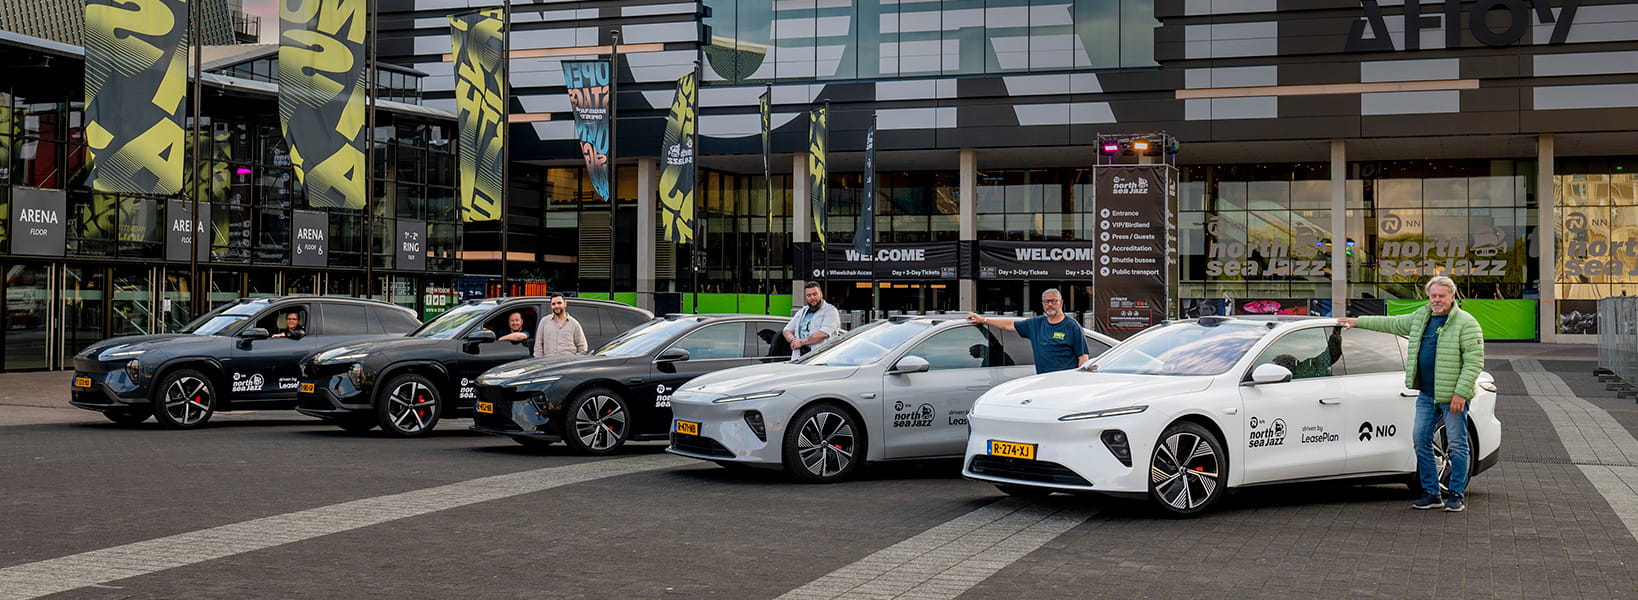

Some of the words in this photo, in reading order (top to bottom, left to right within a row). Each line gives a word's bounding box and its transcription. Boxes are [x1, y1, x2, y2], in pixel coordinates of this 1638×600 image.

[1345, 0, 1578, 51] AHOY
[20, 208, 58, 224] ARENA
[30, 228, 47, 236] FLOOR
[173, 219, 204, 233] AREA
[297, 228, 323, 240] ARENA
[403, 242, 419, 252] RING
[1209, 237, 1289, 258] north
[1382, 236, 1468, 258] north
[1567, 237, 1638, 257] nort
[1015, 248, 1094, 261] WELCOM
[1206, 260, 1259, 276] sea
[1380, 260, 1435, 276] sea
[1564, 259, 1623, 276] sea
[894, 411, 920, 420] north
[893, 420, 911, 428] sea
[1375, 424, 1397, 438] NIO
[1250, 428, 1274, 440] north
[1301, 432, 1339, 443] LeasePlan
[1248, 438, 1265, 448] sea
[1265, 437, 1284, 447] Jazz
[993, 443, 1029, 457] R-274-XJ
